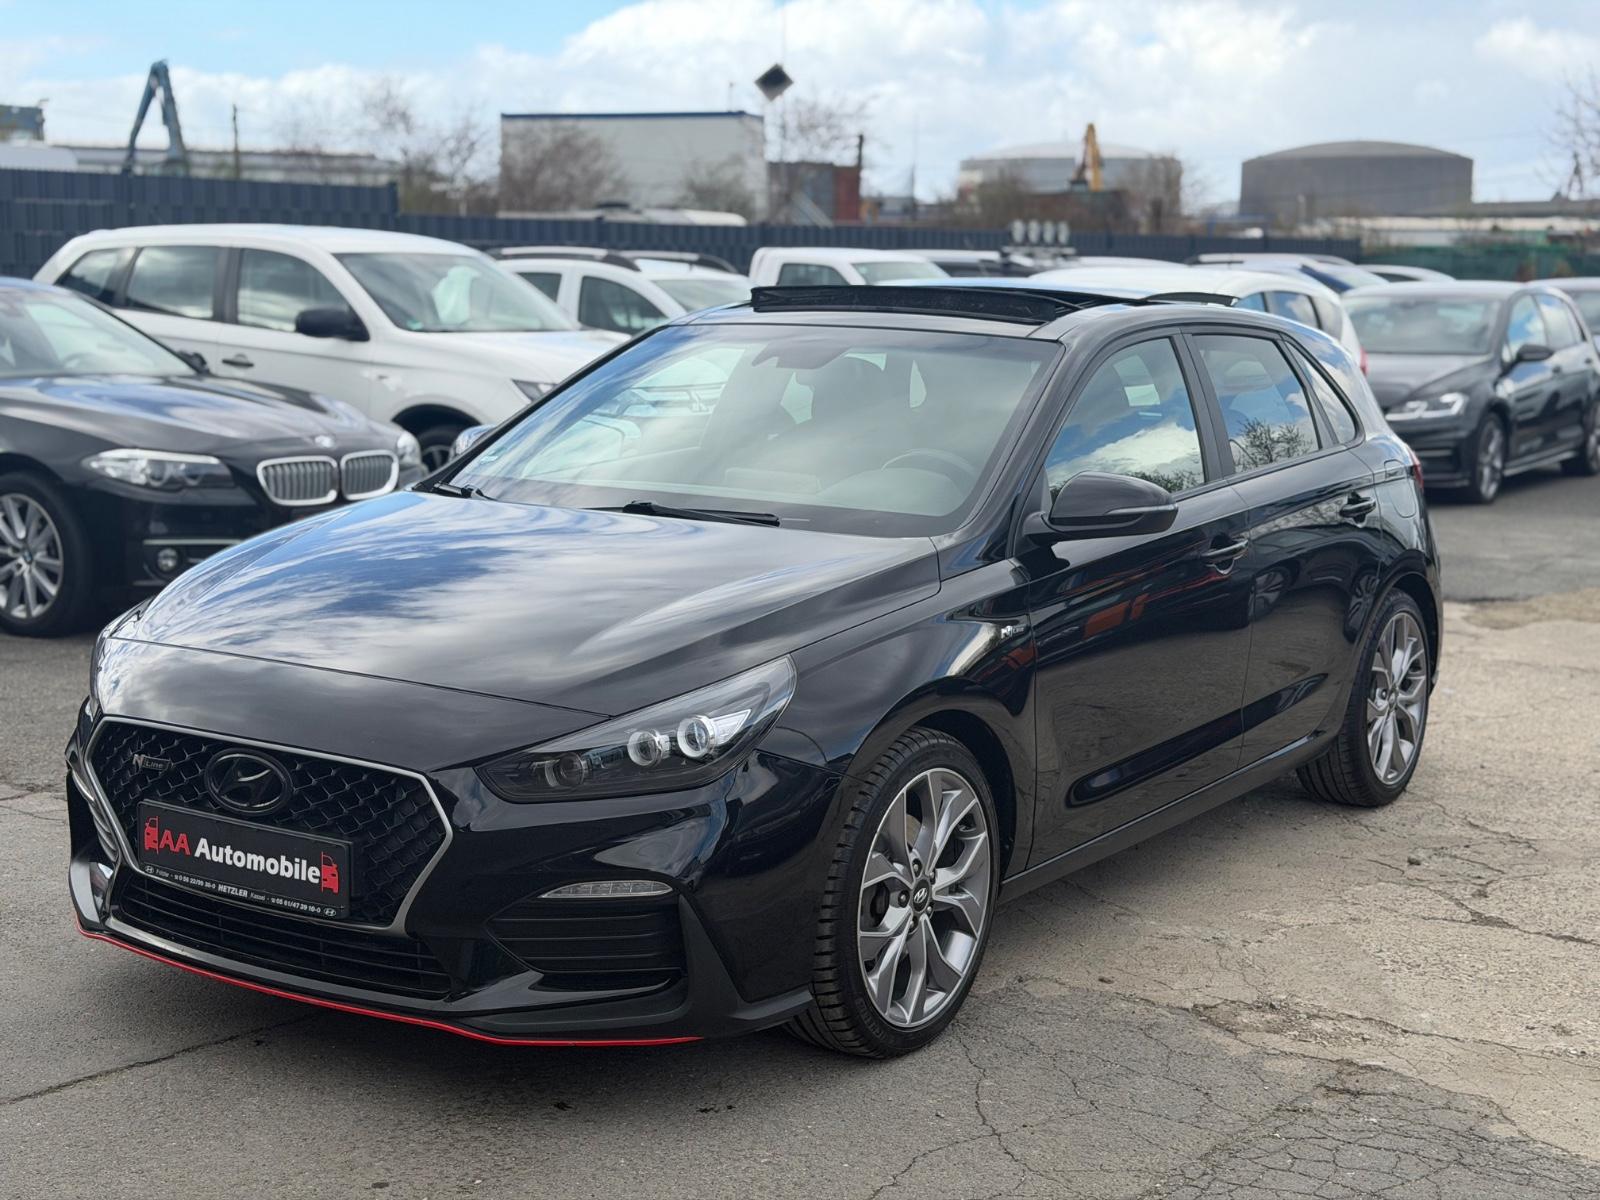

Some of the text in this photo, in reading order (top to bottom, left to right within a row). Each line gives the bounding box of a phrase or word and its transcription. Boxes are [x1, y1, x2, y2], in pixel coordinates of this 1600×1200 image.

[159, 830, 321, 884] AA Automobile
[218, 884, 248, 898] HETZLER
